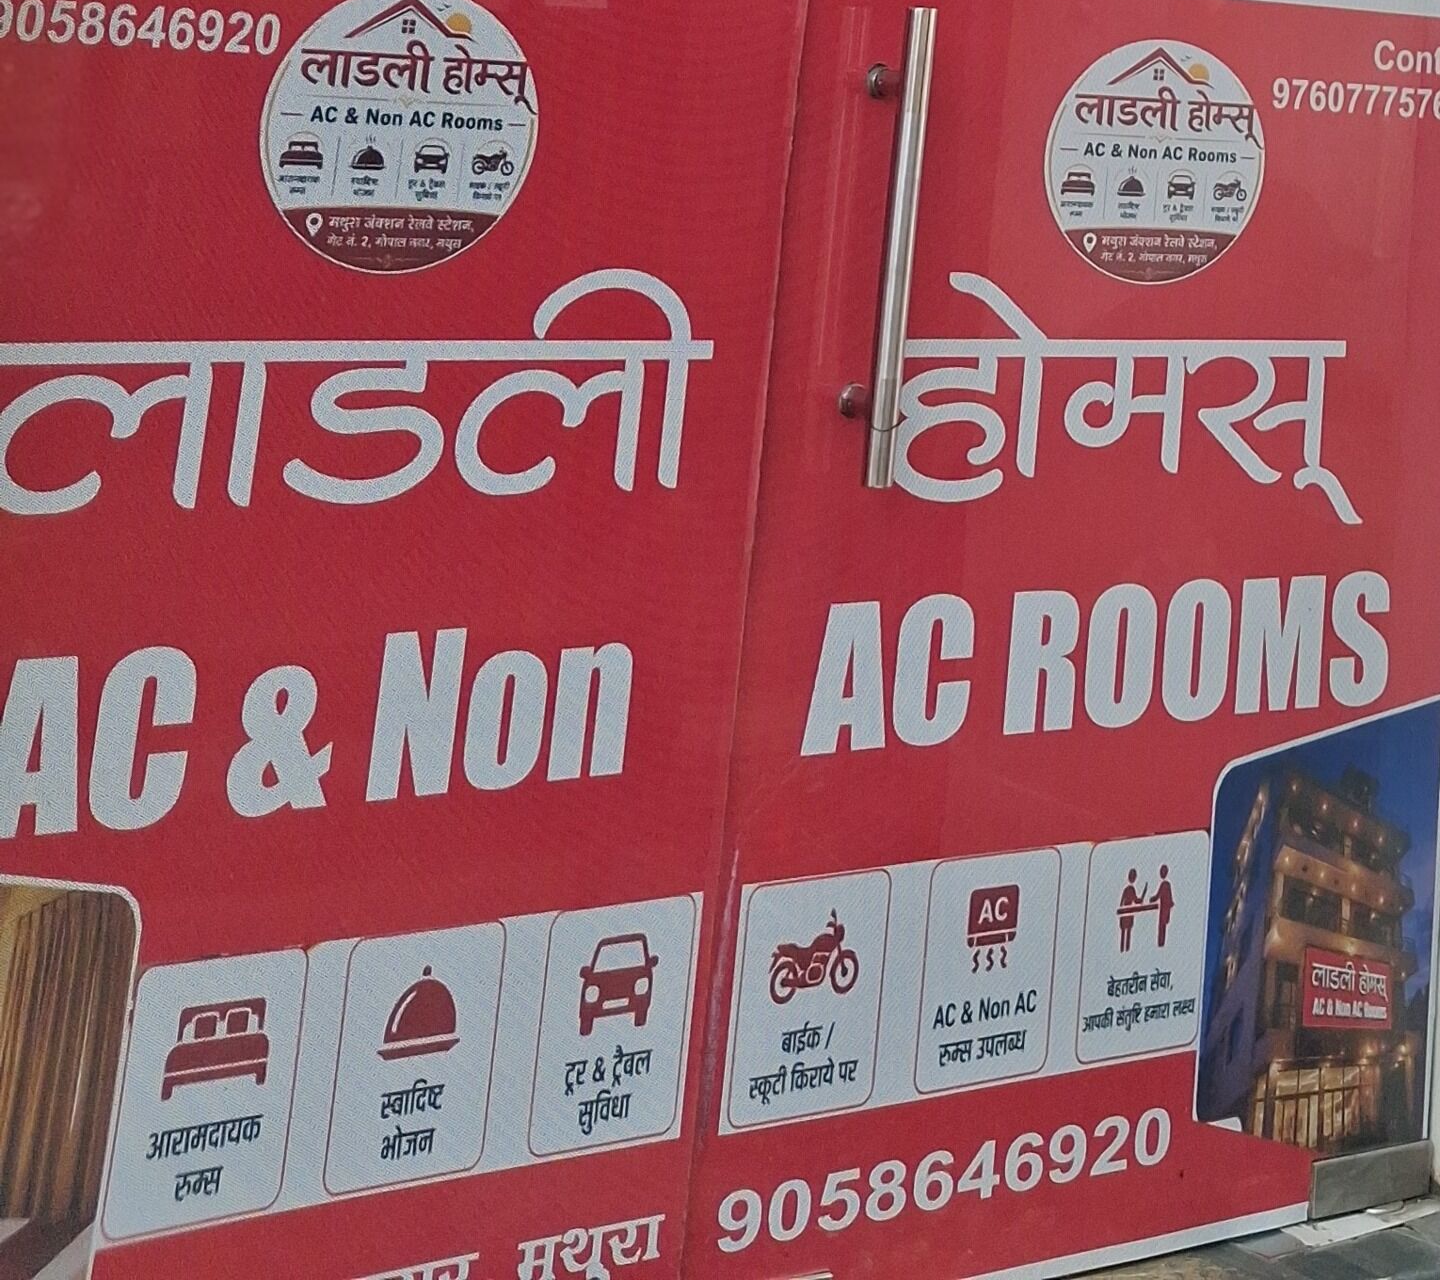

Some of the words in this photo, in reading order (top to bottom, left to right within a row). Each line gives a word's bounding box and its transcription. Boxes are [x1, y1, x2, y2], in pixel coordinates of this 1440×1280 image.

[301, 40, 435, 94] लाडली
[310, 105, 338, 124] AC
[345, 107, 359, 124] &
[365, 108, 403, 127] Non
[409, 110, 436, 128] AC
[442, 113, 503, 131] Rooms
[1075, 86, 1181, 132] लाडली
[1083, 142, 1106, 157] AC
[1110, 144, 1123, 158] &
[1128, 144, 1158, 161] Non
[1162, 145, 1184, 161] AC
[1188, 147, 1237, 164] Rooms
[0, 268, 714, 515] लाडली
[800, 593, 976, 758] AC
[1002, 570, 1391, 736] ROOMS
[0, 645, 197, 838] AC
[226, 665, 333, 818] &
[365, 626, 633, 803] Non
[978, 896, 1010, 923] AC
[1106, 970, 1149, 998] बेहतरीन
[1150, 969, 1174, 992] सेवा,
[933, 1004, 958, 1030] AC
[960, 1002, 974, 1025] &
[978, 995, 1011, 1022] Non
[1015, 989, 1038, 1014] AC
[1082, 1007, 1114, 1033] आपकी
[1142, 1002, 1170, 1023] हमारा
[781, 1022, 823, 1057] बाईक
[825, 1021, 836, 1051] /
[976, 1029, 1027, 1061] उपलब्ध
[564, 1059, 588, 1097] टूर
[592, 1057, 607, 1082] &
[749, 1065, 787, 1105] स्कूटी
[789, 1056, 834, 1092] किराये
[838, 1059, 859, 1086] पर
[578, 1088, 632, 1136] सुविधा
[146, 1113, 263, 1162] आरामदायक
[381, 1125, 436, 1162] भोजन
[718, 1107, 1171, 1253] 9058646920
